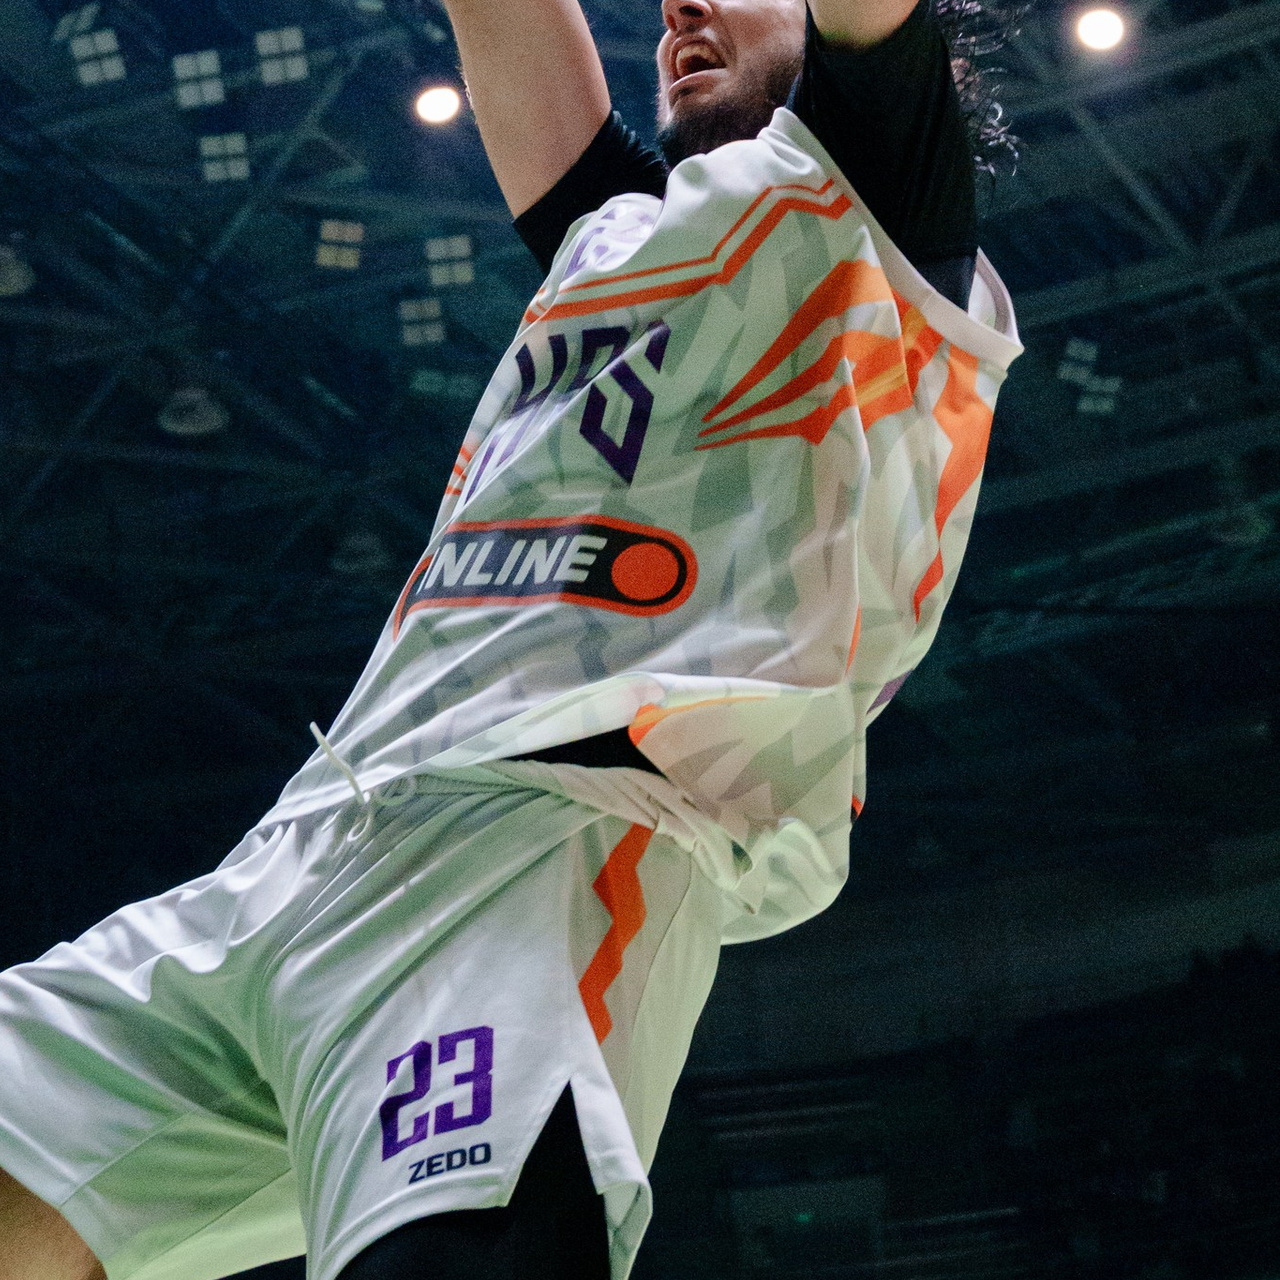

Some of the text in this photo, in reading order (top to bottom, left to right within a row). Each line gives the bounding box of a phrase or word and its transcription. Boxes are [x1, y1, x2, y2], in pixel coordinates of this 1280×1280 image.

[418, 533, 608, 593] NLINE
[379, 1024, 494, 1162] 23
[408, 1141, 492, 1185] ZEDO
